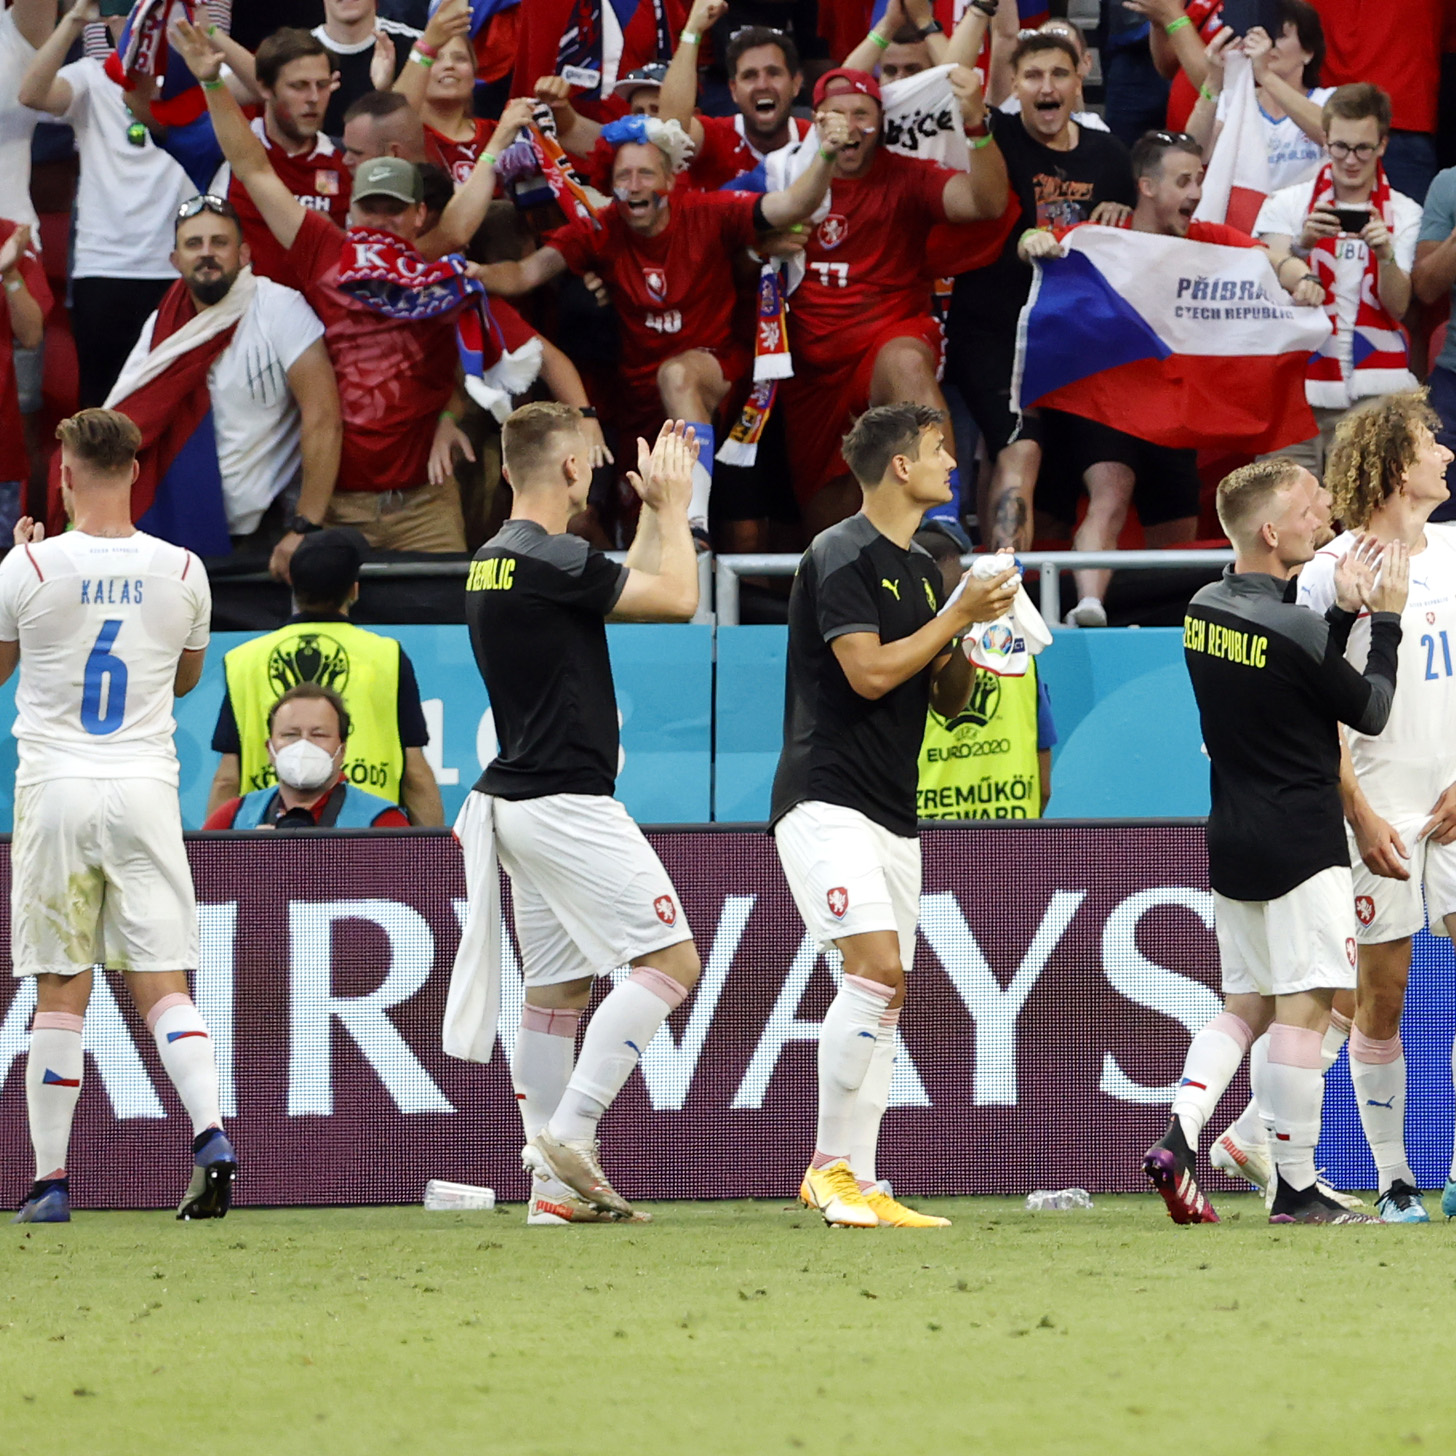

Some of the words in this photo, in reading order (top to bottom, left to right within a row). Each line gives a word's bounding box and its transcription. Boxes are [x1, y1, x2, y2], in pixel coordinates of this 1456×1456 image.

[1175, 273, 1264, 302] PŘÍBRA
[1174, 305, 1220, 321] CZECH
[81, 578, 144, 605] KALAS
[1208, 620, 1268, 669] REPUBLIC
[1420, 630, 1453, 680] 21
[81, 619, 129, 735] 6
